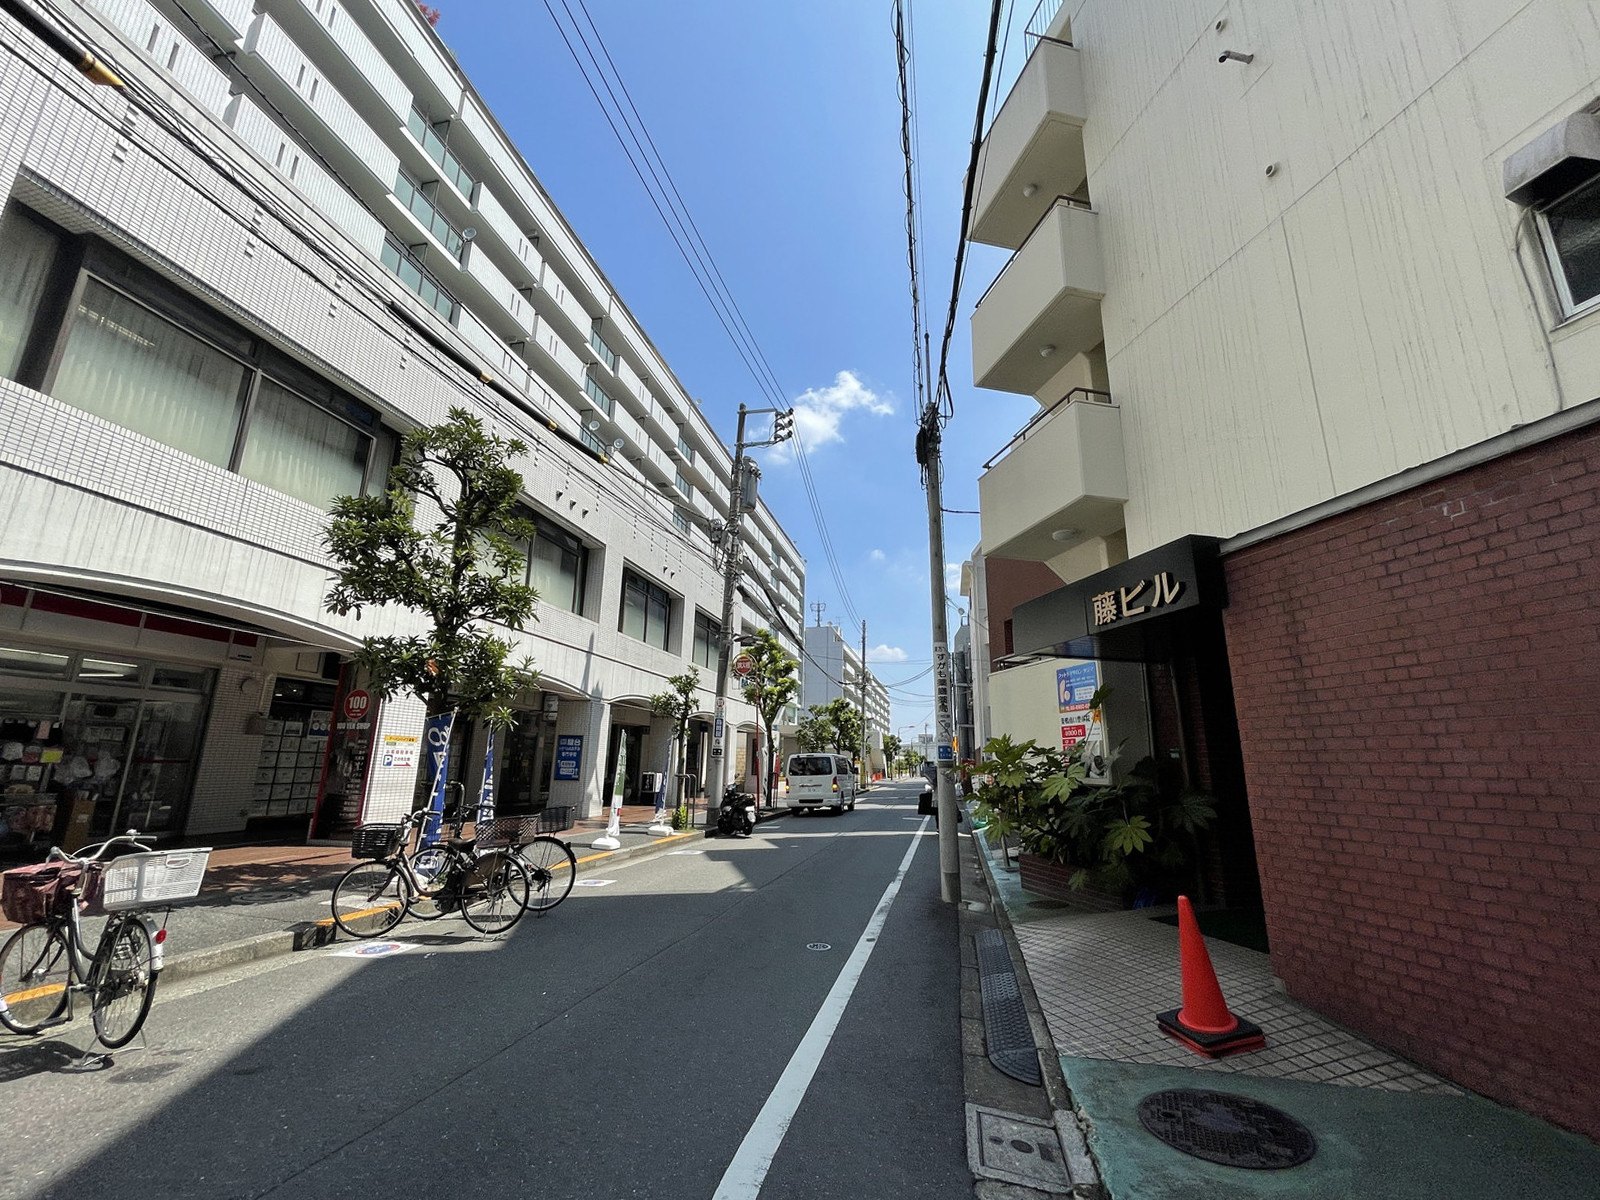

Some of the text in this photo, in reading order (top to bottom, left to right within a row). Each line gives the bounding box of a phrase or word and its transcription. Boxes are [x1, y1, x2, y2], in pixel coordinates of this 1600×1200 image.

[1091, 571, 1180, 626] 藤ビル
[349, 696, 367, 709] 100
[356, 722, 371, 730] SHOP
[384, 756, 392, 766] P
